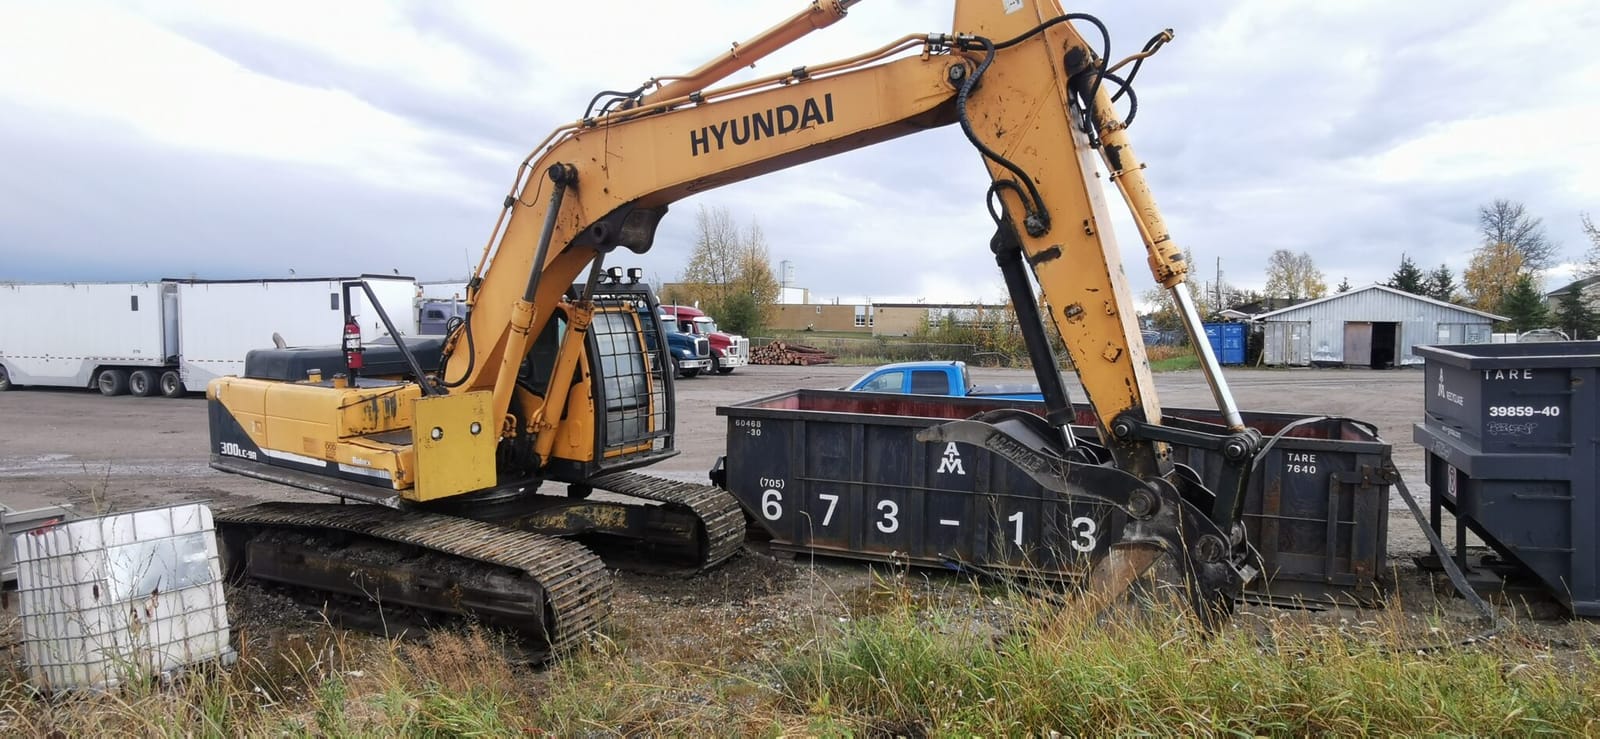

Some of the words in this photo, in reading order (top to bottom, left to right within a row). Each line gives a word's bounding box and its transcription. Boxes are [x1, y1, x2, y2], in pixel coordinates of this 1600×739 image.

[690, 93, 834, 157] HYUNDAI
[1484, 369, 1534, 380] TARE
[1488, 405, 1561, 417] 39859-40
[746, 428, 762, 437] -30
[1287, 452, 1317, 463] TARE
[1287, 464, 1317, 475] 7640
[758, 476, 786, 490] (705)
